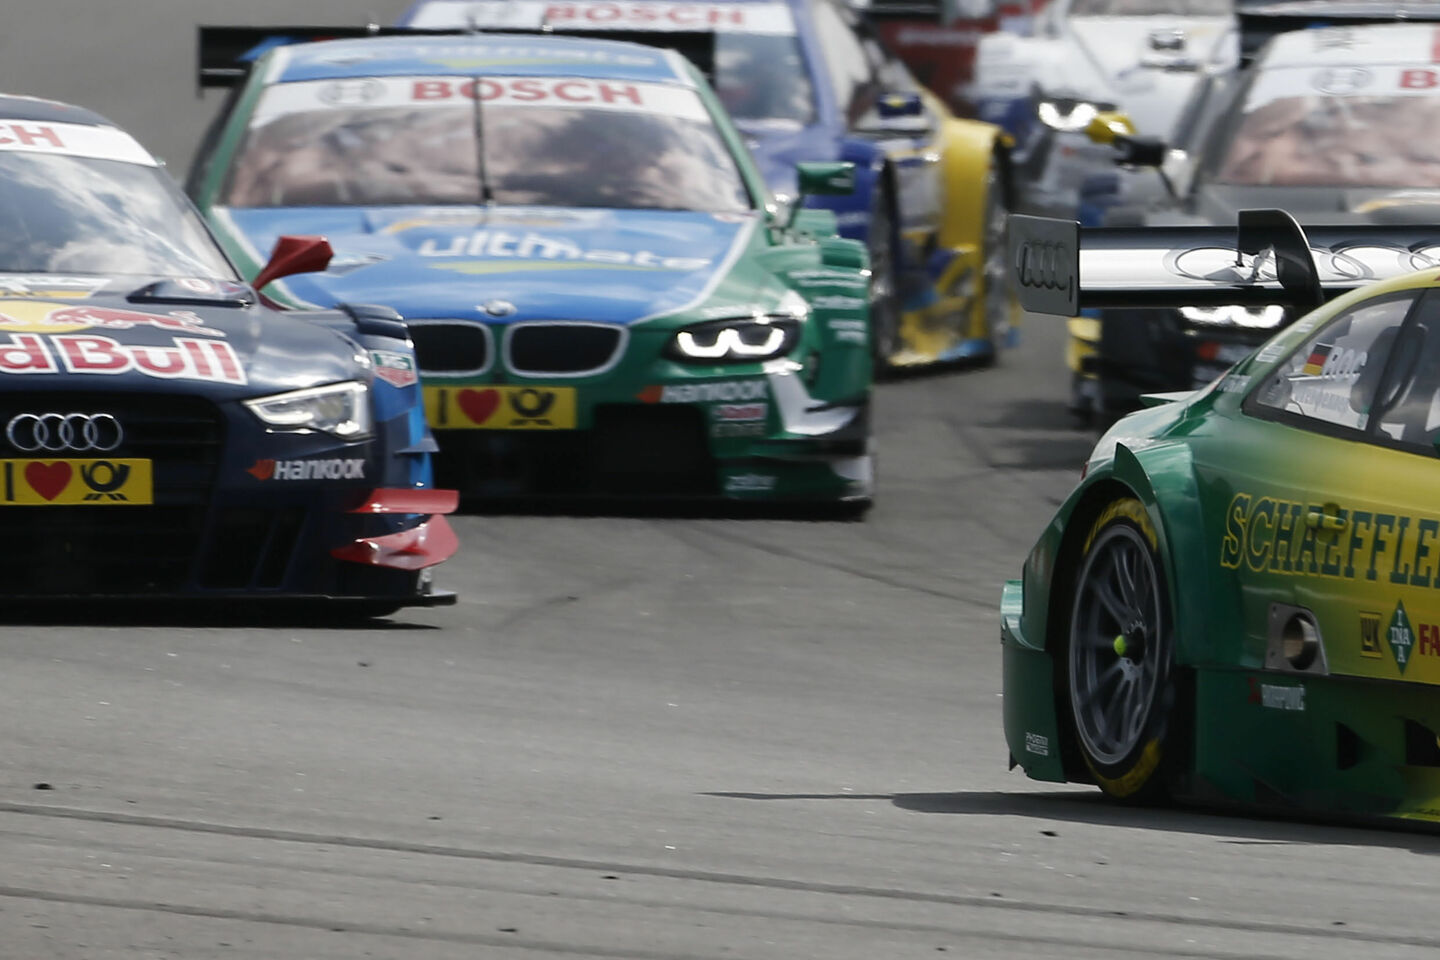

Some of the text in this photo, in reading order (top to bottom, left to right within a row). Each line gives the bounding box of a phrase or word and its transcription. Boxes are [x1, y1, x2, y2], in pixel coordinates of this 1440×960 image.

[545, 3, 745, 24] BOSCH
[411, 79, 643, 105] BOSCH
[60, 335, 244, 384] Bull
